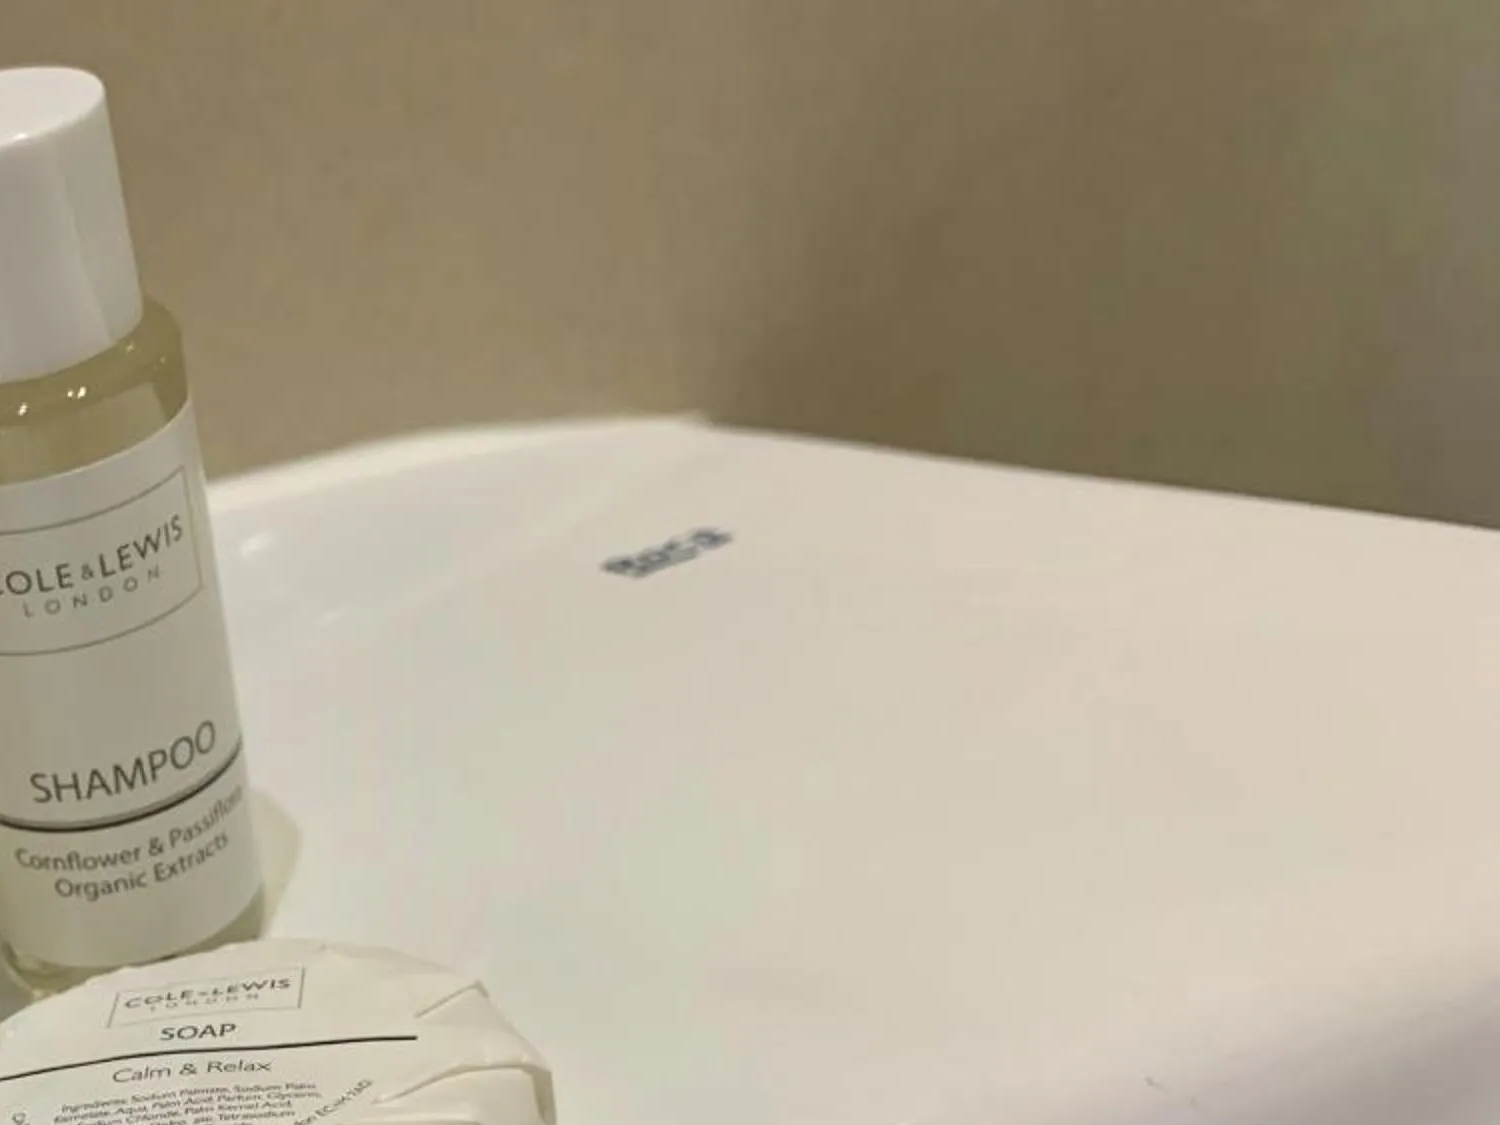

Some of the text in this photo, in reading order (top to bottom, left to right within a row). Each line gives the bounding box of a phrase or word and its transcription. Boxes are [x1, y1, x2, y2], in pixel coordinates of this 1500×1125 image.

[23, 567, 161, 618] LONDON
[30, 720, 217, 804] SHAMPOO
[15, 847, 140, 872] Cornflower
[148, 836, 164, 858] &
[54, 832, 229, 902] Organic Extracts
[160, 1022, 238, 1042] SOAP
[112, 1059, 273, 1083] Calm & Relax
